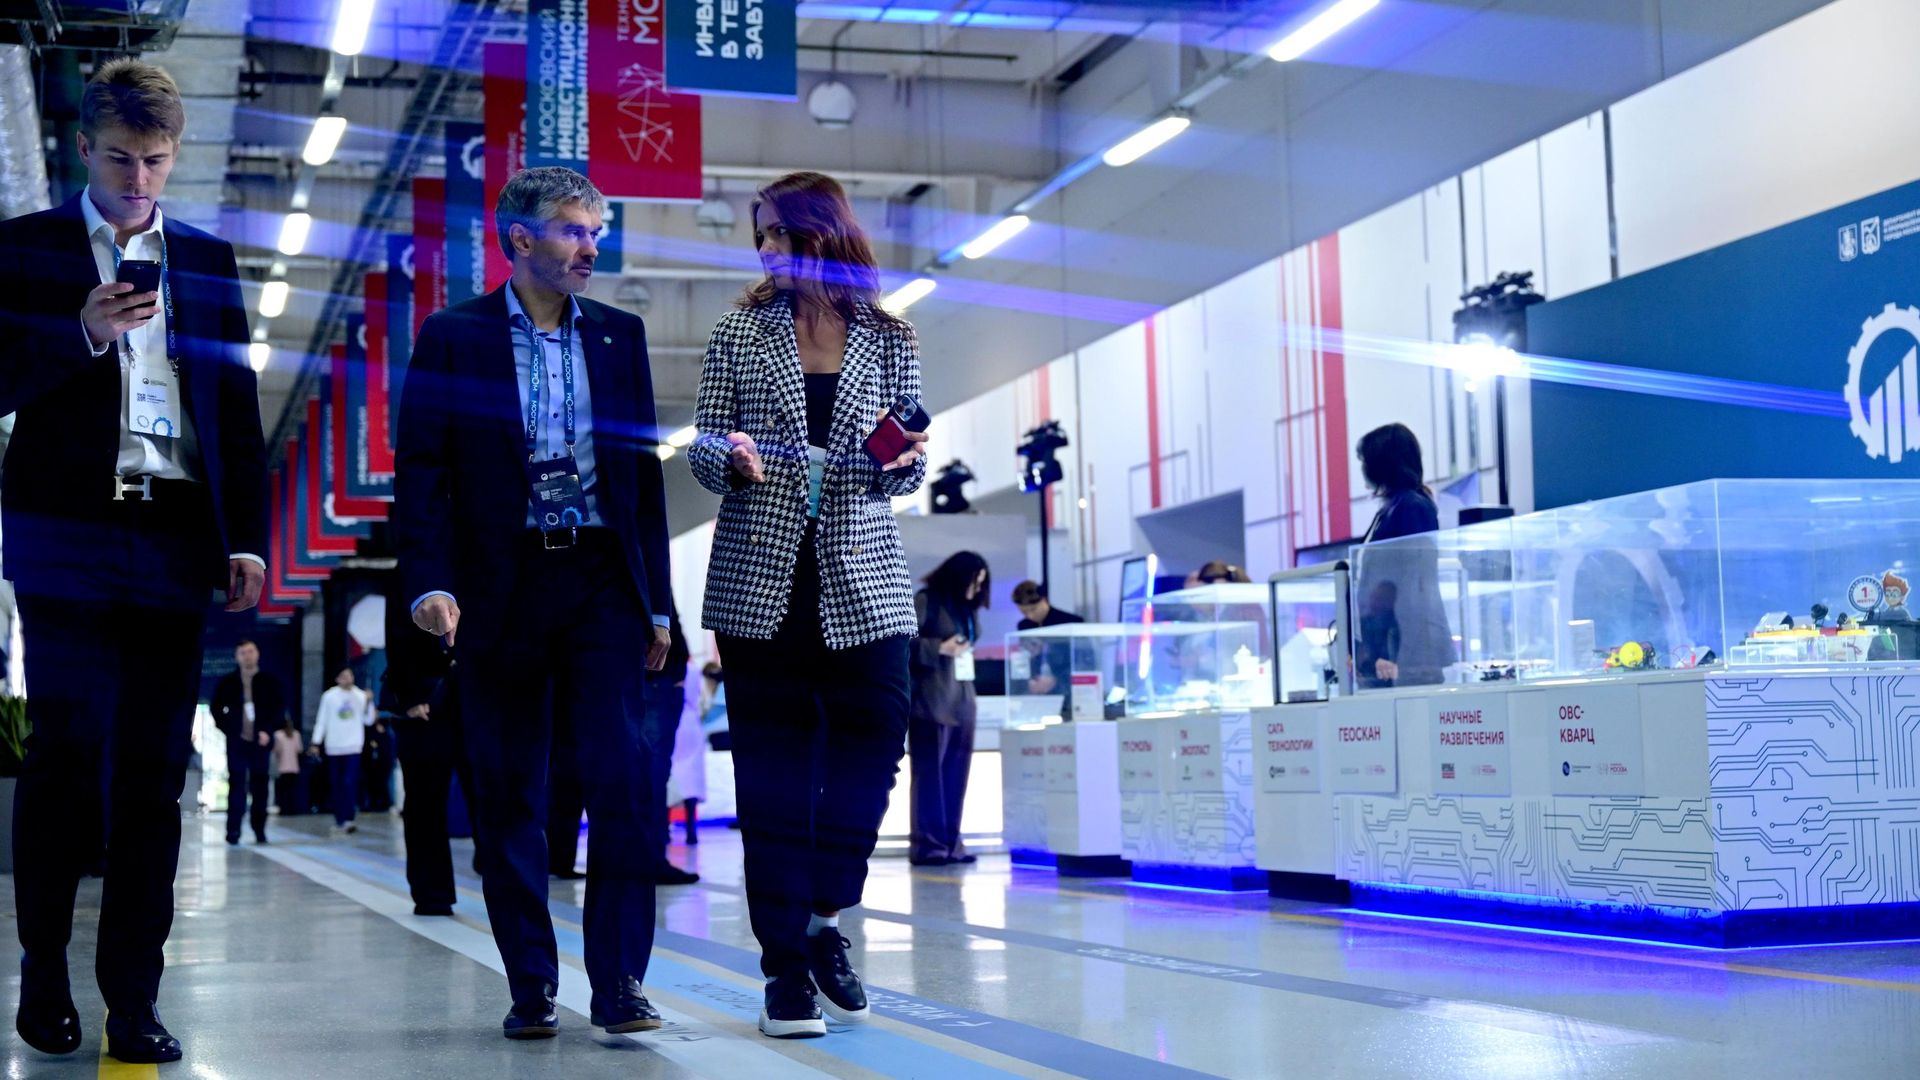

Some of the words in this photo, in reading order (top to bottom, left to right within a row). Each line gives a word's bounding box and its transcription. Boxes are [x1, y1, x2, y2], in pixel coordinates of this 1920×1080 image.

[616, 0, 630, 42] ТЕХН
[695, 0, 714, 57] ИНВ
[720, 40, 739, 59] В
[536, 8, 557, 147] МОСКОВСКИЙ
[531, 353, 540, 392] МОСПРОМ
[562, 347, 571, 384] МОСПРОМ
[528, 400, 537, 439] МОСПРОМ
[565, 392, 574, 431] МОСПРОМ
[1439, 710, 1483, 725] НАУЧНЫЕ
[1558, 705, 1585, 720] ОВС-
[1338, 726, 1381, 742] ГЕОСКАН
[1440, 730, 1505, 746] РАЗВЛЕЧЕНИЯ
[1559, 728, 1595, 745] КВАРЦ
